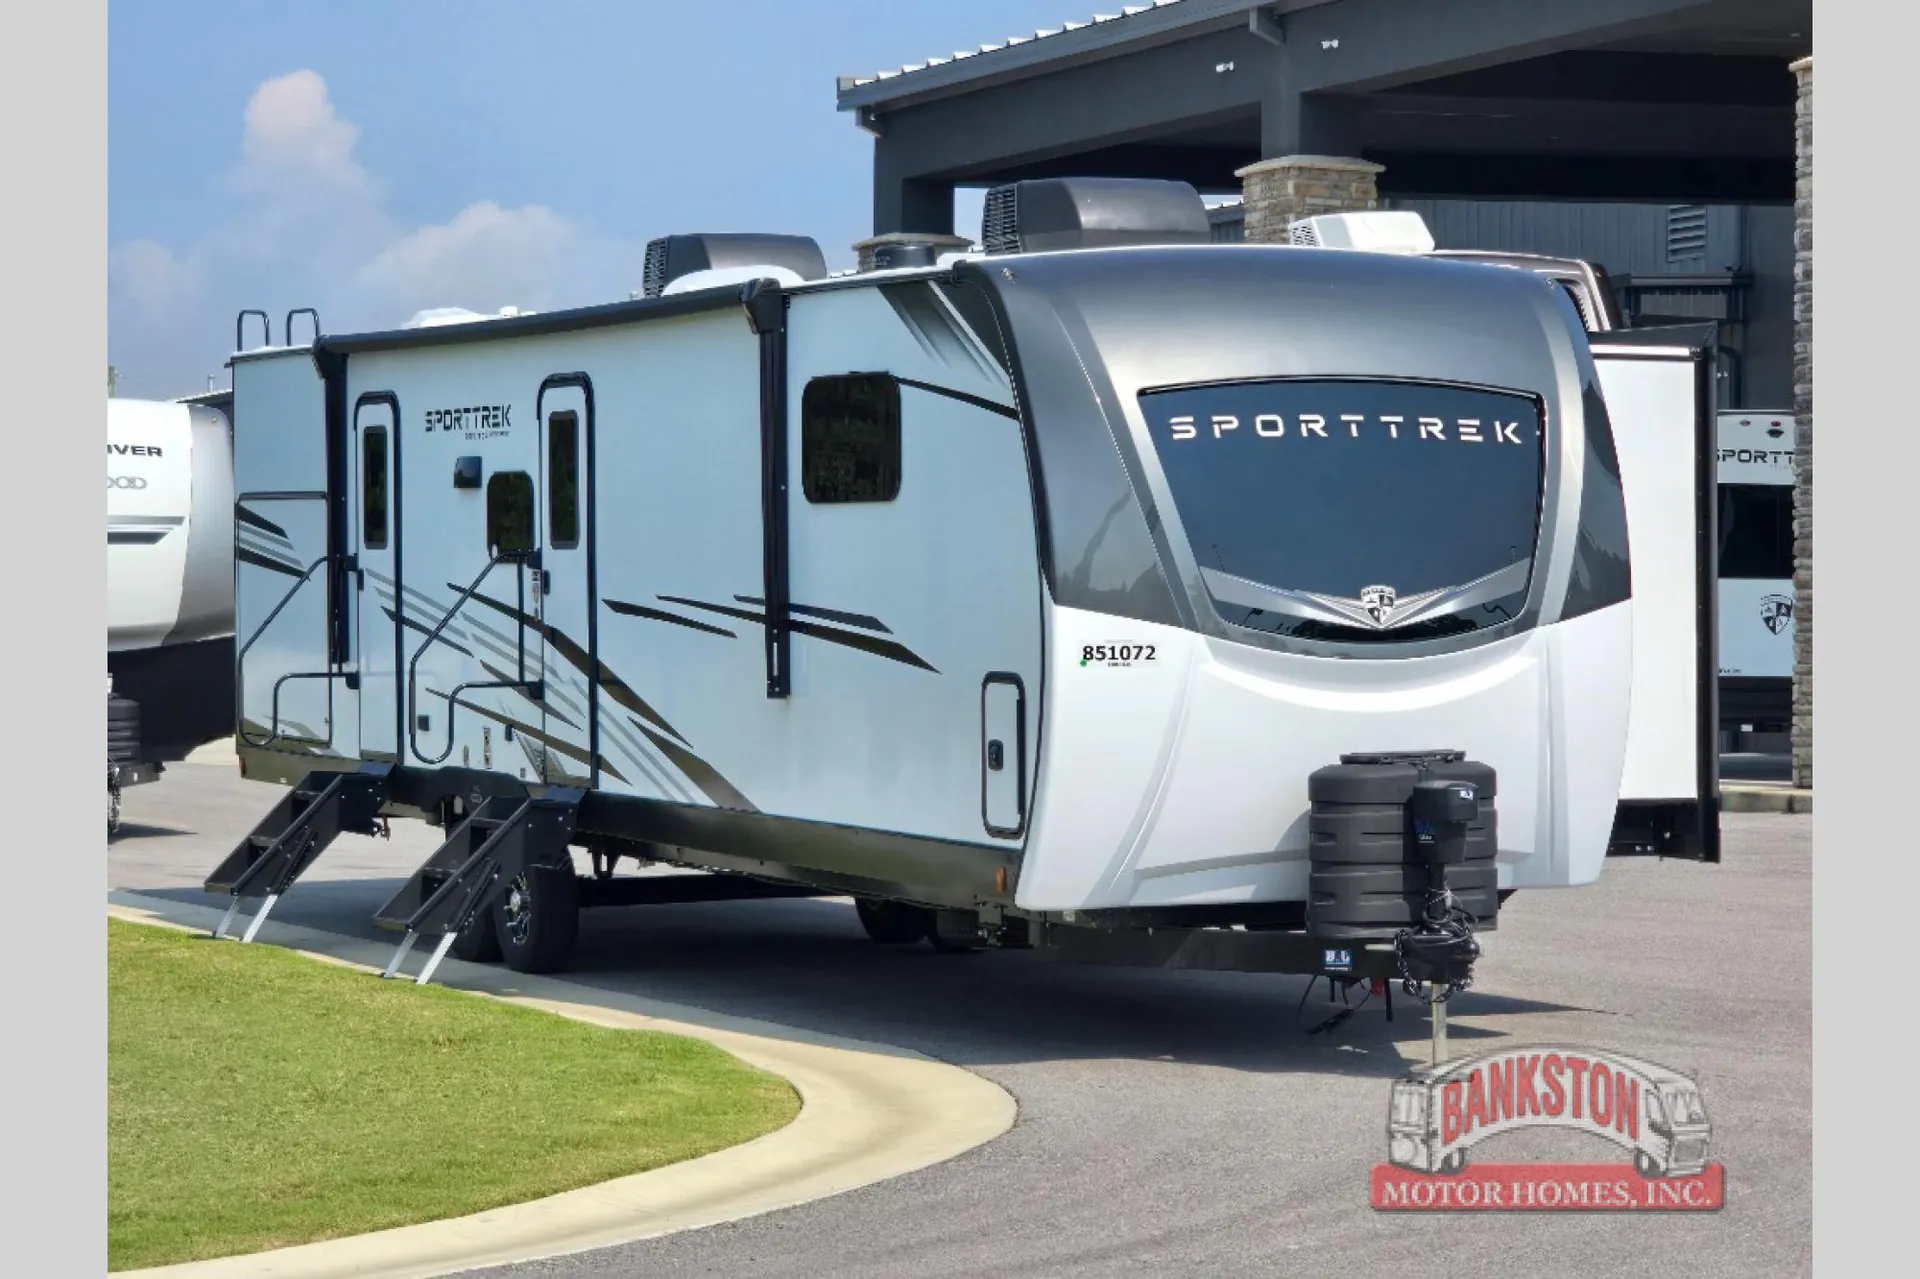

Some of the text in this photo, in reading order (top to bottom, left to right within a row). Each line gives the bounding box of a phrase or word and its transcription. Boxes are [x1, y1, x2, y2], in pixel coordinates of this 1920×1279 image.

[425, 404, 511, 432] SPORTTREK
[1169, 414, 1522, 444] SPORTTREK
[1717, 449, 1795, 465] PORTT
[1082, 645, 1156, 661] 851072
